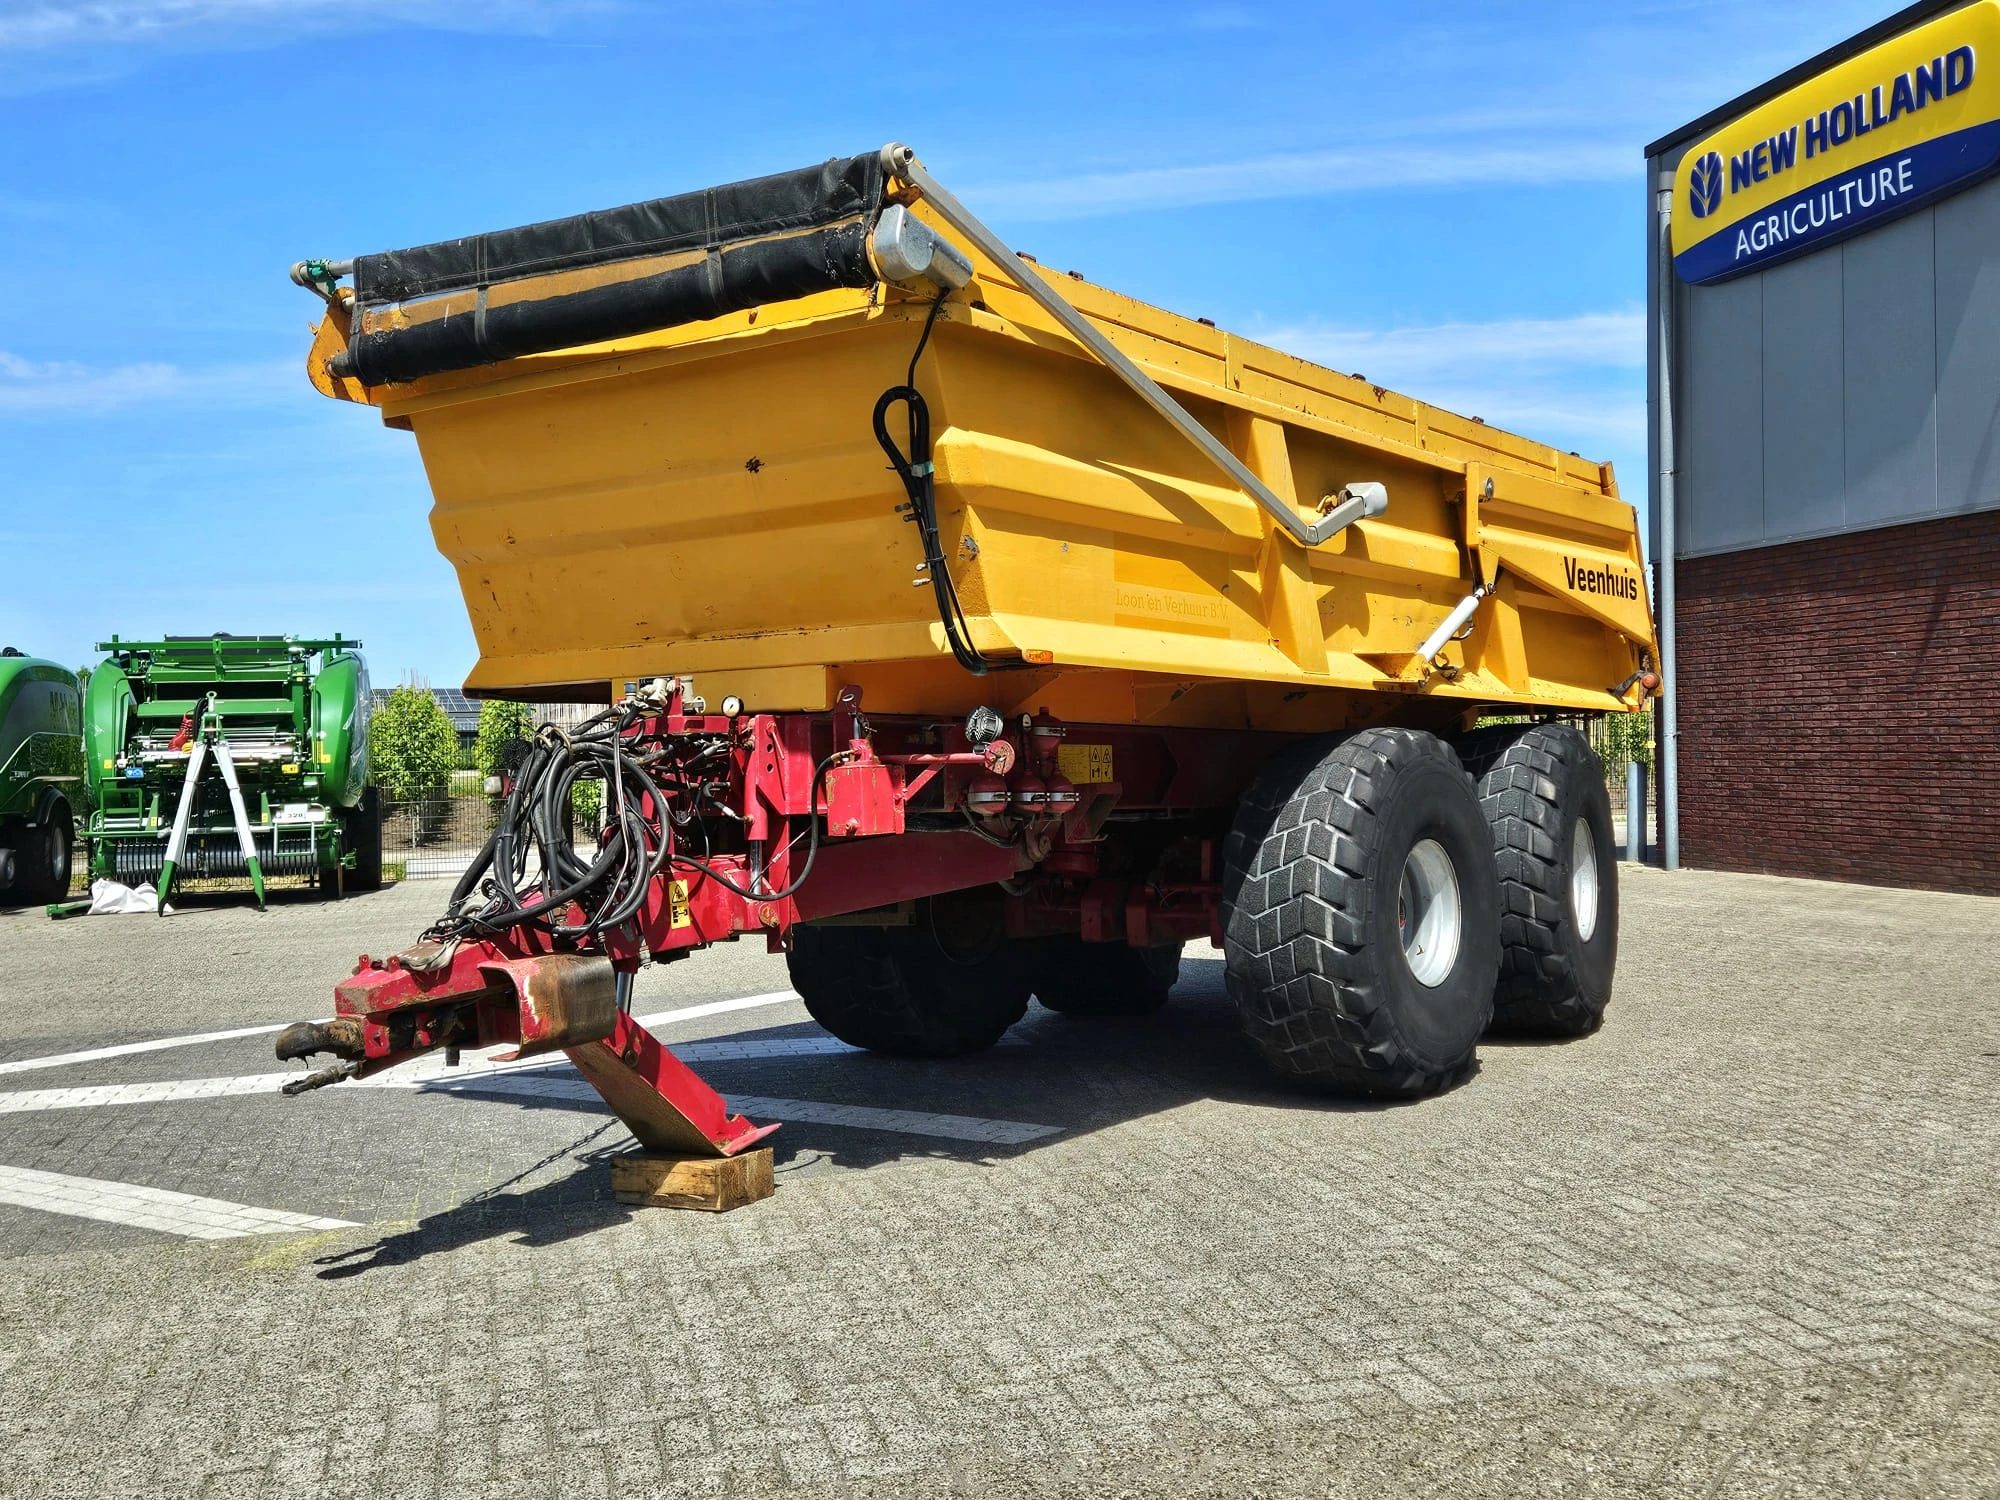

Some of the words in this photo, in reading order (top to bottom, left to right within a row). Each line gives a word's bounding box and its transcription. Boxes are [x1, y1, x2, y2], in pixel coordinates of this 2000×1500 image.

[1731, 125, 1799, 194] NEW
[1805, 45, 1975, 159] HOLLAND
[1735, 158, 1914, 260] AGRICULTURE
[1116, 588, 1144, 609] Loon
[1147, 598, 1161, 611] en
[1163, 595, 1207, 618] Verhuur
[1563, 556, 1637, 600] Veenhuis
